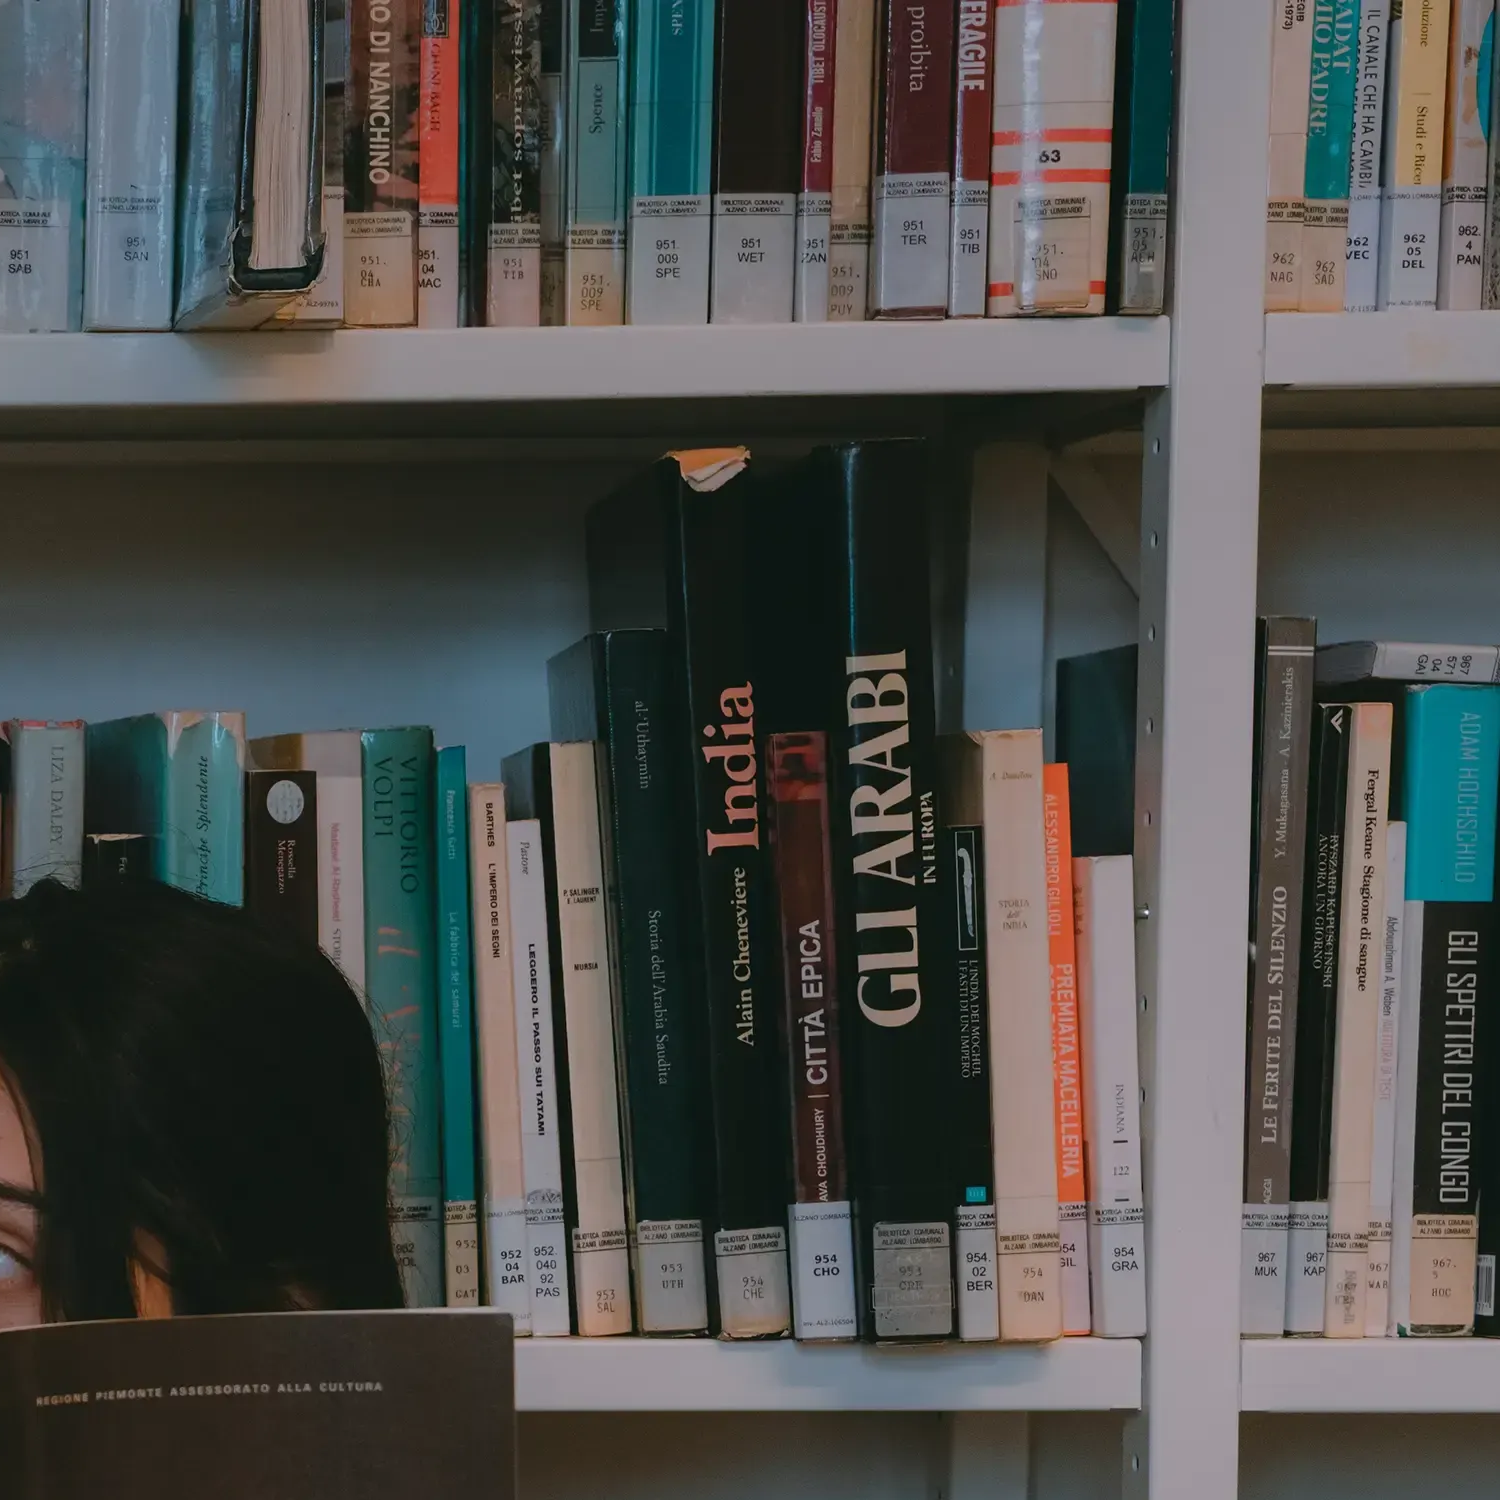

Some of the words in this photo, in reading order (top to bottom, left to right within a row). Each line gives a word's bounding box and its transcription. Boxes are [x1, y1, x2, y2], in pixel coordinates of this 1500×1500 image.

[369, 30, 391, 55] DI
[368, 61, 392, 184] NANCHINO
[657, 254, 679, 265] 009
[737, 252, 765, 263] WET
[740, 238, 761, 249] 951
[1403, 234, 1426, 244] 962
[1407, 247, 1422, 257] 05
[655, 267, 680, 279] SPE
[1402, 259, 1426, 269] DEL
[701, 681, 761, 856] India
[844, 649, 916, 886] ARABI
[918, 791, 935, 861] EUROPA
[920, 865, 936, 884] IN
[730, 867, 752, 982] Cheneviere
[1267, 886, 1287, 985] SILENZIO
[799, 920, 824, 999] EPICA
[855, 906, 923, 1028] GLI
[1448, 930, 1478, 965] GLI
[735, 987, 756, 1046] Alain
[1056, 963, 1076, 1054] PREMIATA
[1267, 989, 1283, 1030] DEL
[1443, 973, 1477, 1064] SPETTRI
[797, 1008, 829, 1085] CITTÀ
[1262, 1036, 1282, 1111] FERITE
[1441, 1073, 1473, 1114] DEL
[1059, 1060, 1080, 1177] MACELLERIA
[1261, 1116, 1278, 1144] LE
[1439, 1120, 1470, 1203] CONGO
[812, 1266, 840, 1278] CHO
[814, 1253, 838, 1265] 954
[36, 1393, 90, 1408] REGIONE
[95, 1388, 163, 1402] PIEMONTE
[170, 1383, 271, 1397] ASSESSORATO
[277, 1382, 312, 1393] ALLA
[319, 1381, 383, 1393] CULTURA
